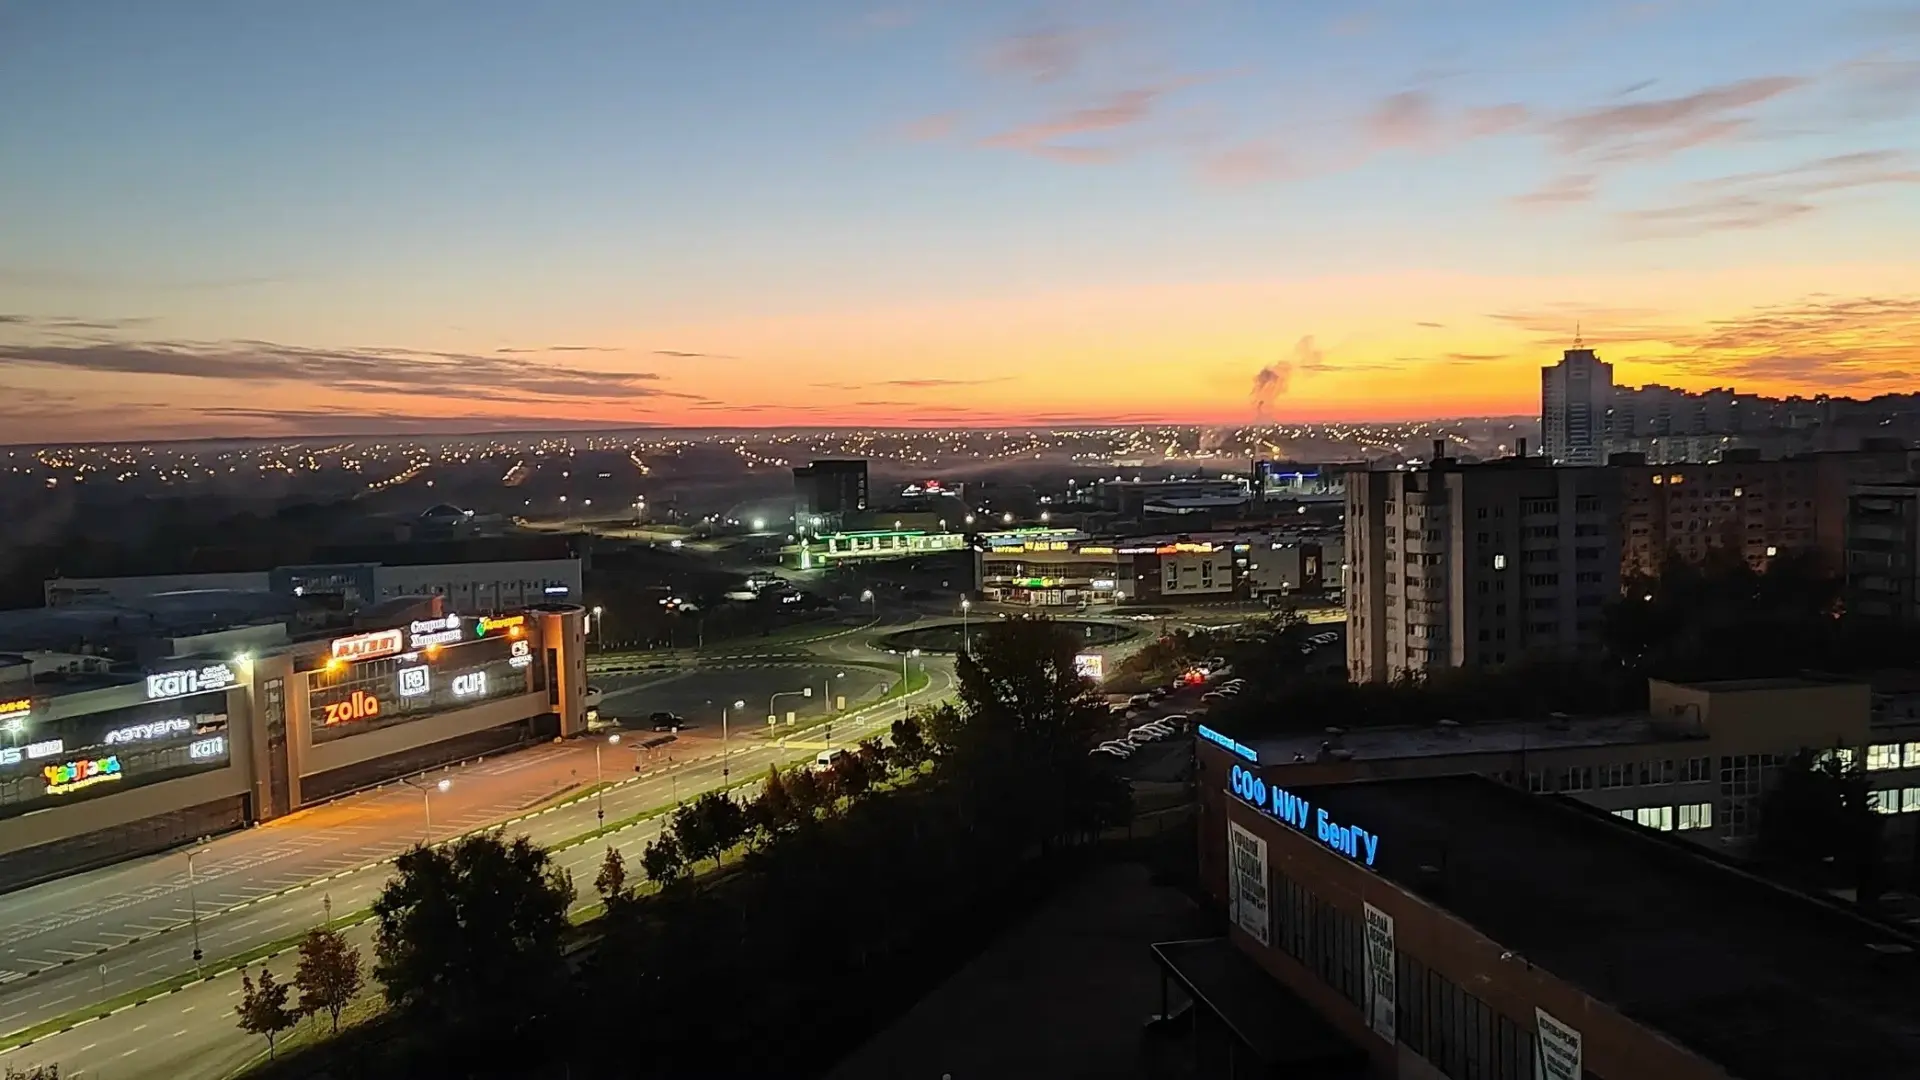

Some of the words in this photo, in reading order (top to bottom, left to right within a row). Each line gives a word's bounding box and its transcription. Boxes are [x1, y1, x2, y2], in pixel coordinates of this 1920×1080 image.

[147, 668, 198, 699] kari
[324, 690, 379, 725] zolla
[1232, 764, 1267, 806] СОФ
[1272, 785, 1310, 829] НИУ
[1317, 808, 1379, 866] БелГУ
